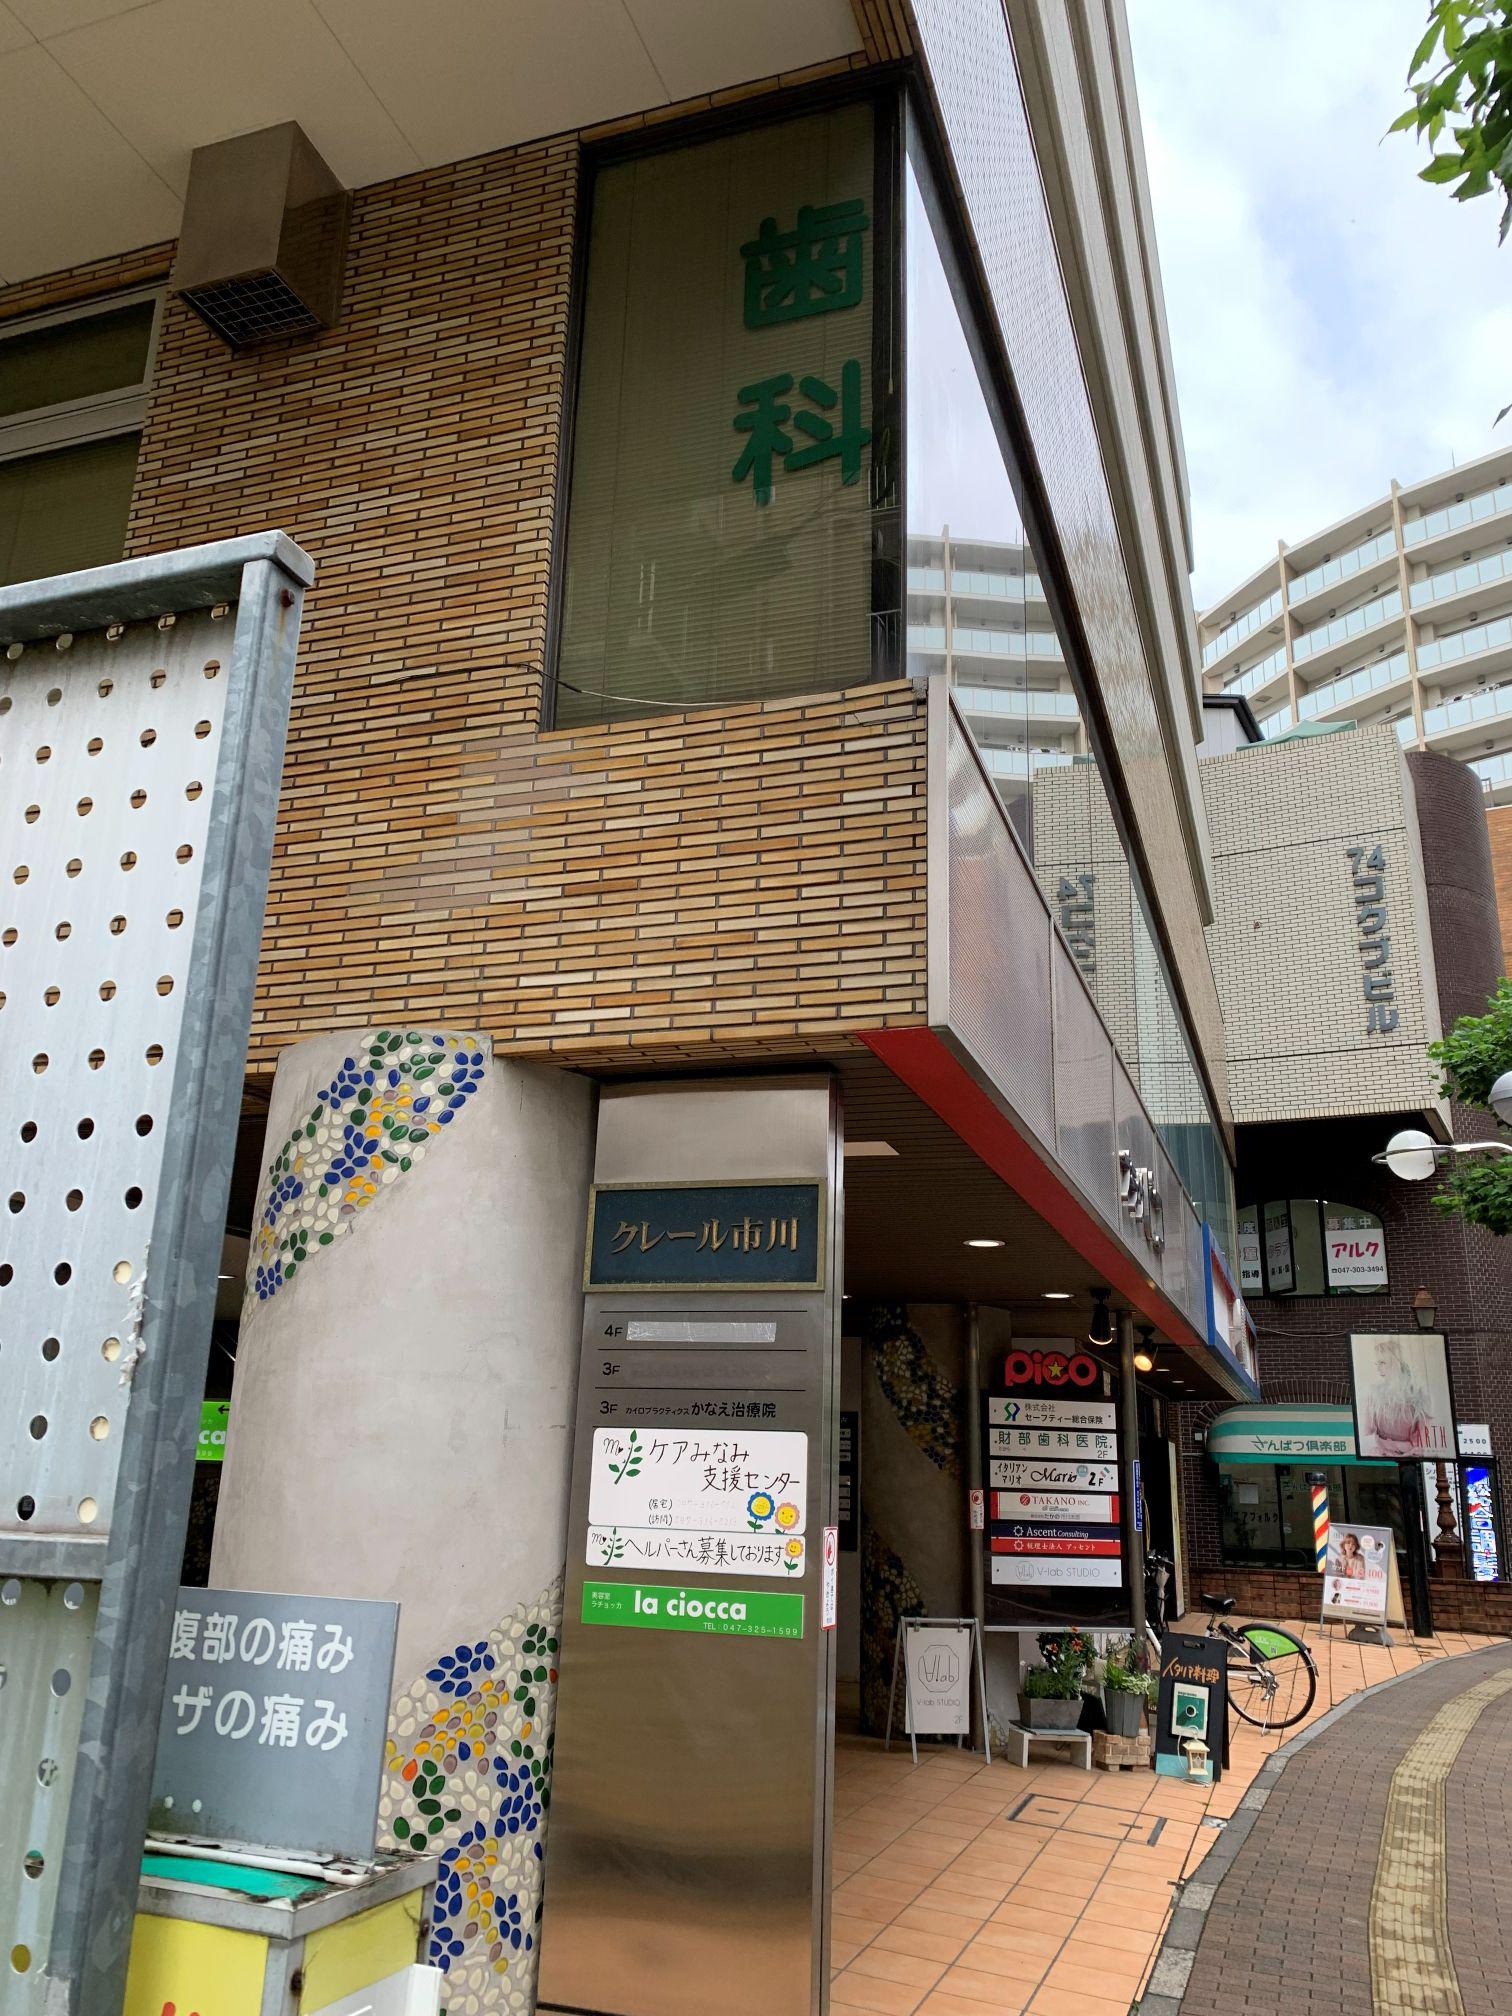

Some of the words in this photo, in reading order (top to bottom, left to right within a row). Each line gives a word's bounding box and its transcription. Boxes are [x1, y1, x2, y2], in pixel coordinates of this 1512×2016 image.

[731, 198, 874, 508] 歯科
[1346, 844, 1400, 1035] 74コクブビル
[610, 1216, 798, 1255] クレール市川
[1331, 1242, 1379, 1258] アルク
[604, 1325, 623, 1337] 4F
[602, 1362, 621, 1376] 3F
[599, 1400, 619, 1414] 3F
[691, 1401, 776, 1418] かなえ治療院
[1024, 1403, 1056, 1413] 株式会社
[1024, 1413, 1104, 1425] セーフティー総合保険
[998, 1431, 1108, 1449] 財部歯科医院
[649, 1439, 750, 1464] ケアみなみ
[1097, 1450, 1108, 1459] 2F
[997, 1462, 1028, 1474] イタリアン
[1030, 1467, 1078, 1483] Mario
[700, 1465, 800, 1494] 支援センター
[1001, 1475, 1022, 1485] マリオ
[1031, 1495, 1076, 1506] TAKANO
[1026, 1526, 1057, 1537] Ascent
[1057, 1530, 1089, 1539] Consulting
[624, 1536, 785, 1567] ヘルパーさん募集しております
[1066, 1567, 1100, 1577] STUDIO
[634, 1590, 658, 1614] la
[666, 1592, 747, 1621] ciocca
